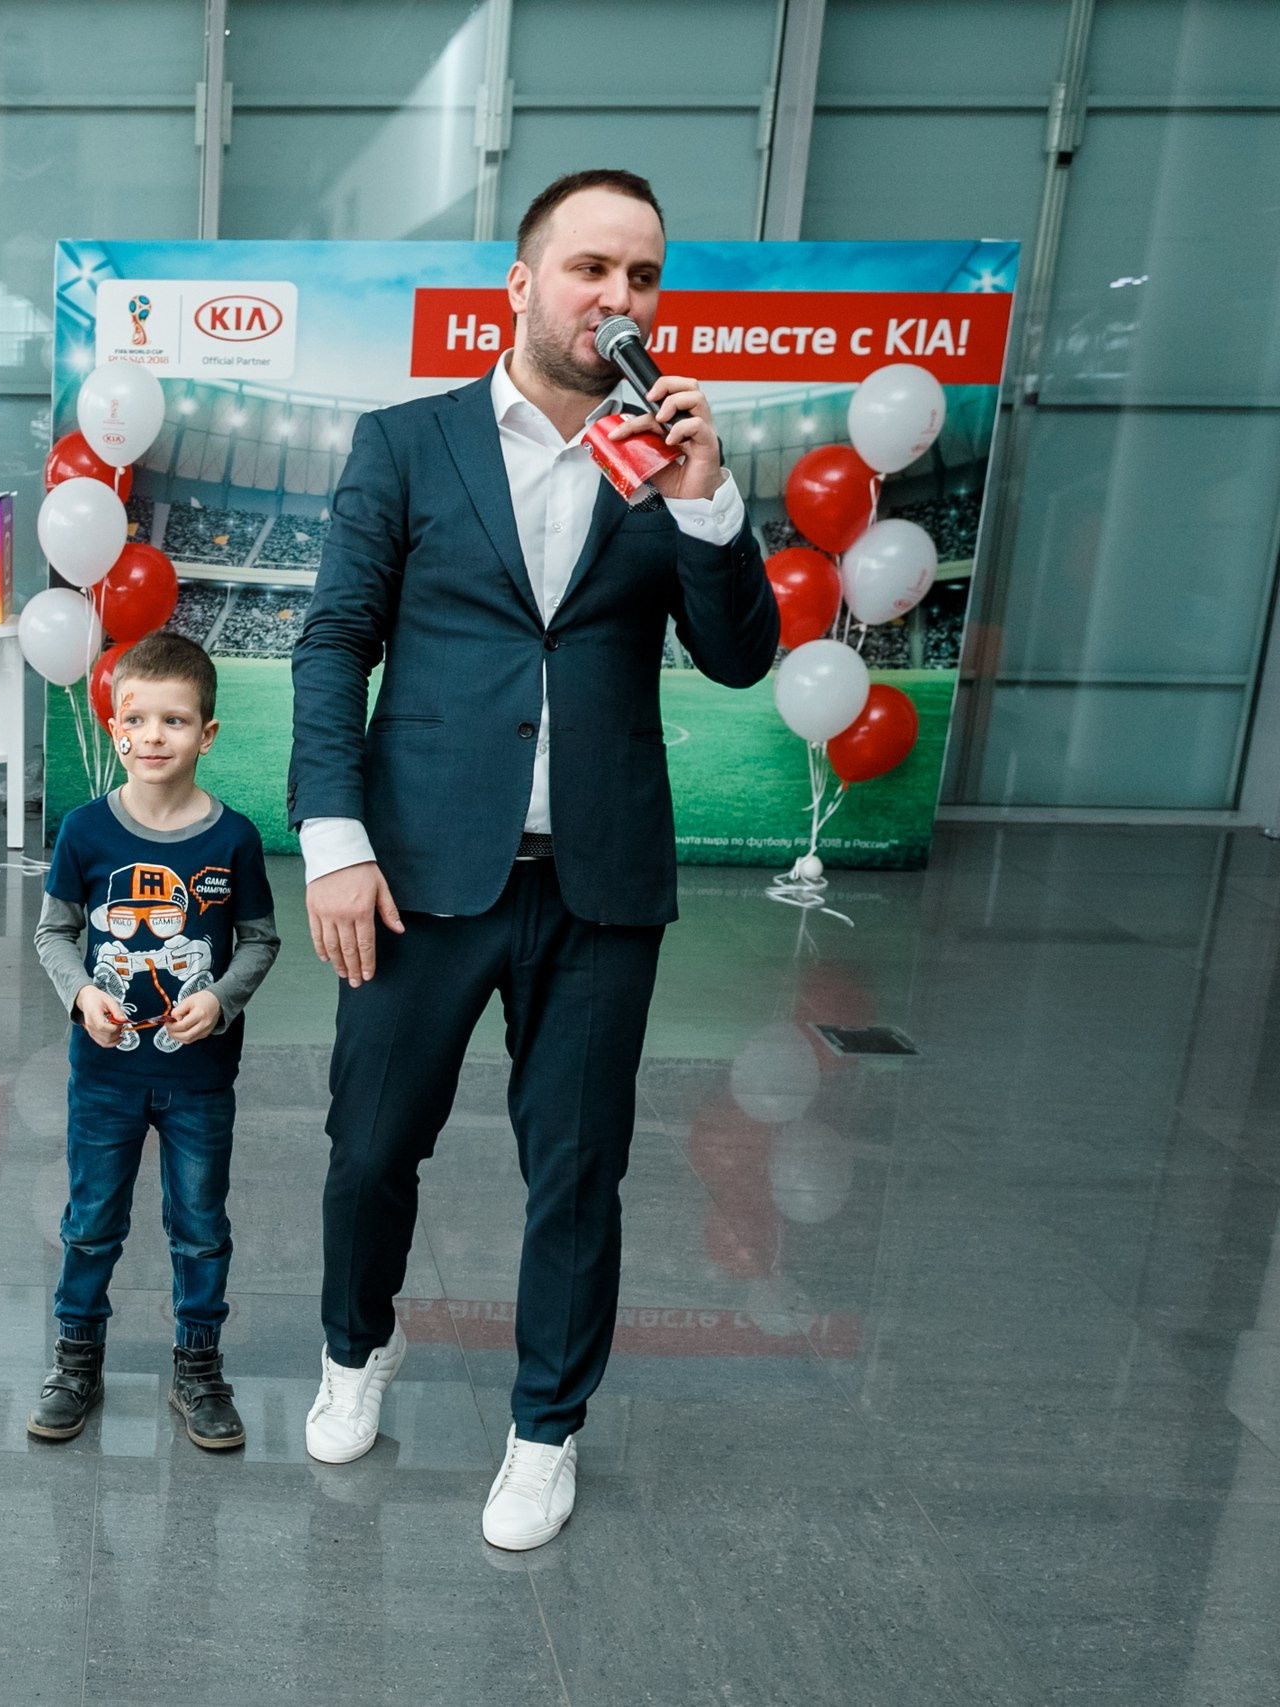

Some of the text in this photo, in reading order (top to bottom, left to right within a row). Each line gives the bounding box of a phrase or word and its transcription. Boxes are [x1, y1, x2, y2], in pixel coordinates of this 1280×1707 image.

[210, 306, 267, 331] KIA
[446, 314, 501, 350] На
[691, 326, 837, 354] вместе
[850, 327, 873, 354] с
[884, 318, 970, 356] KIA!
[202, 356, 271, 366] Official Partner
[205, 876, 228, 886] GAME
[152, 917, 181, 926] GAMES
